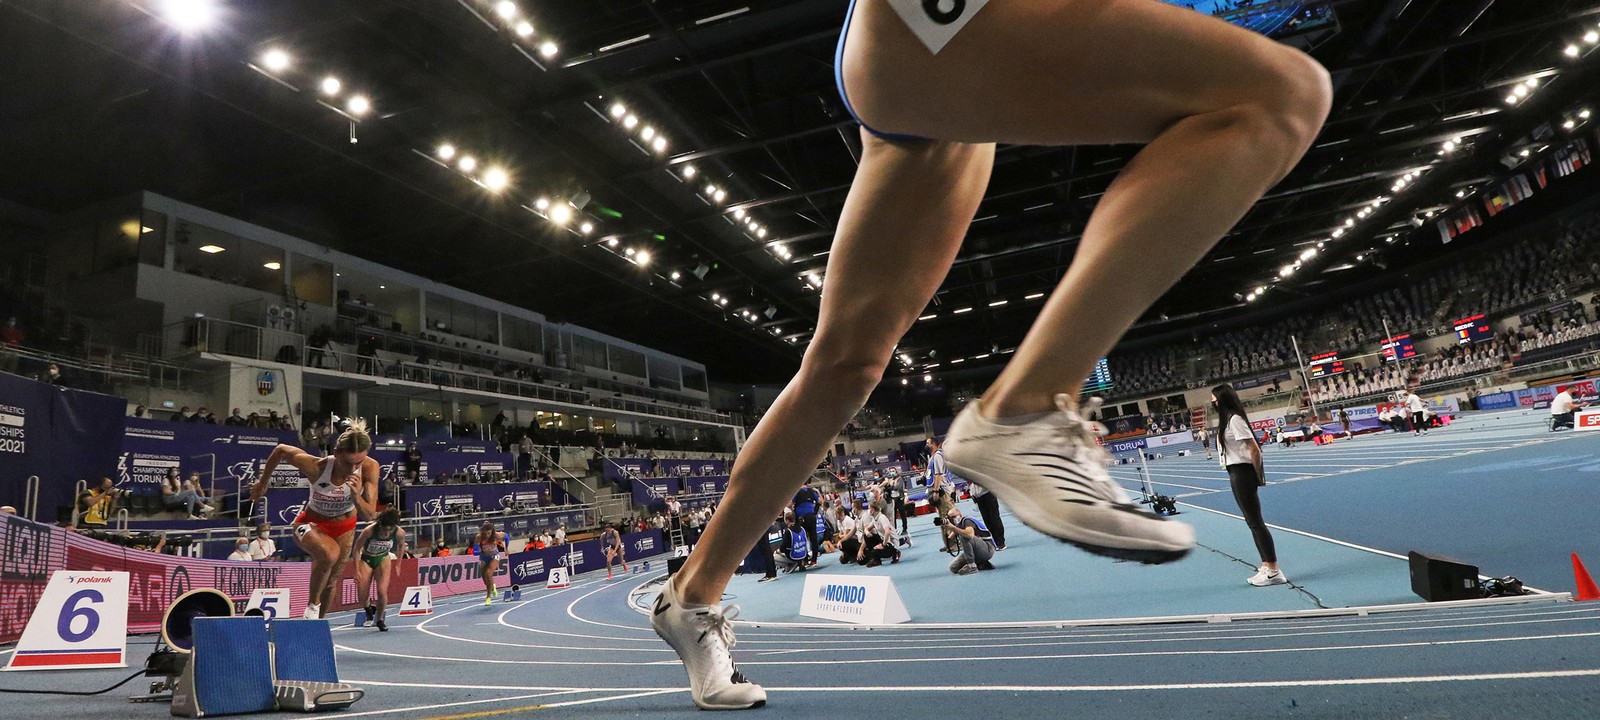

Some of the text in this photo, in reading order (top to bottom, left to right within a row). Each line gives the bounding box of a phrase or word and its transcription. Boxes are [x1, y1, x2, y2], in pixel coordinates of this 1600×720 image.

[0, 439, 25, 453] 2021
[133, 474, 162, 483] TORUŃ
[77, 576, 112, 584] polanik
[419, 563, 463, 585] TOYO
[553, 572, 560, 583] 3
[408, 592, 420, 608] 4
[825, 584, 866, 604] MONDO
[57, 589, 104, 642] 6
[260, 598, 278, 624] 5
